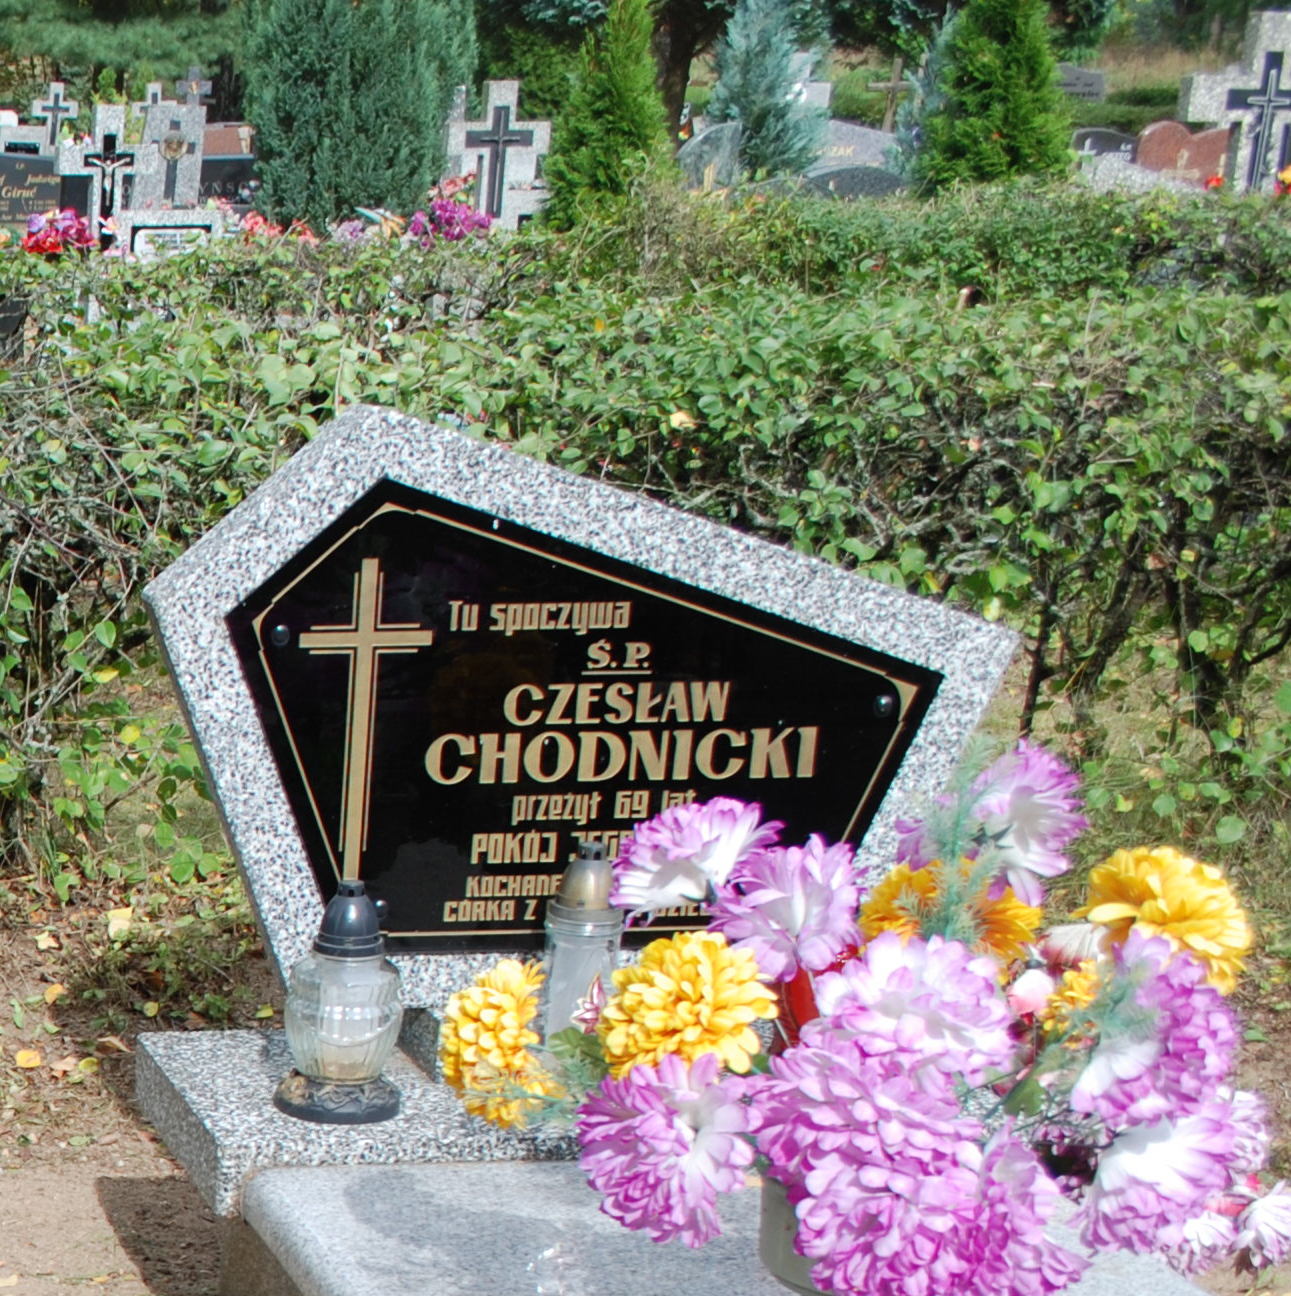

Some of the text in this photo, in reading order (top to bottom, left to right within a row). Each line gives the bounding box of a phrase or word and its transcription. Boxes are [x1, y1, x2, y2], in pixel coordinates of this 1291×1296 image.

[448, 600, 632, 636] Tu spoczywa
[503, 680, 731, 727] CZESŁAW
[424, 725, 820, 786] CHODNICKI
[511, 791, 603, 826] przeżył
[613, 790, 651, 819] 69
[470, 829, 559, 864] POKÓJ
[442, 898, 517, 923] CÓRKA
[523, 899, 539, 921] Z
